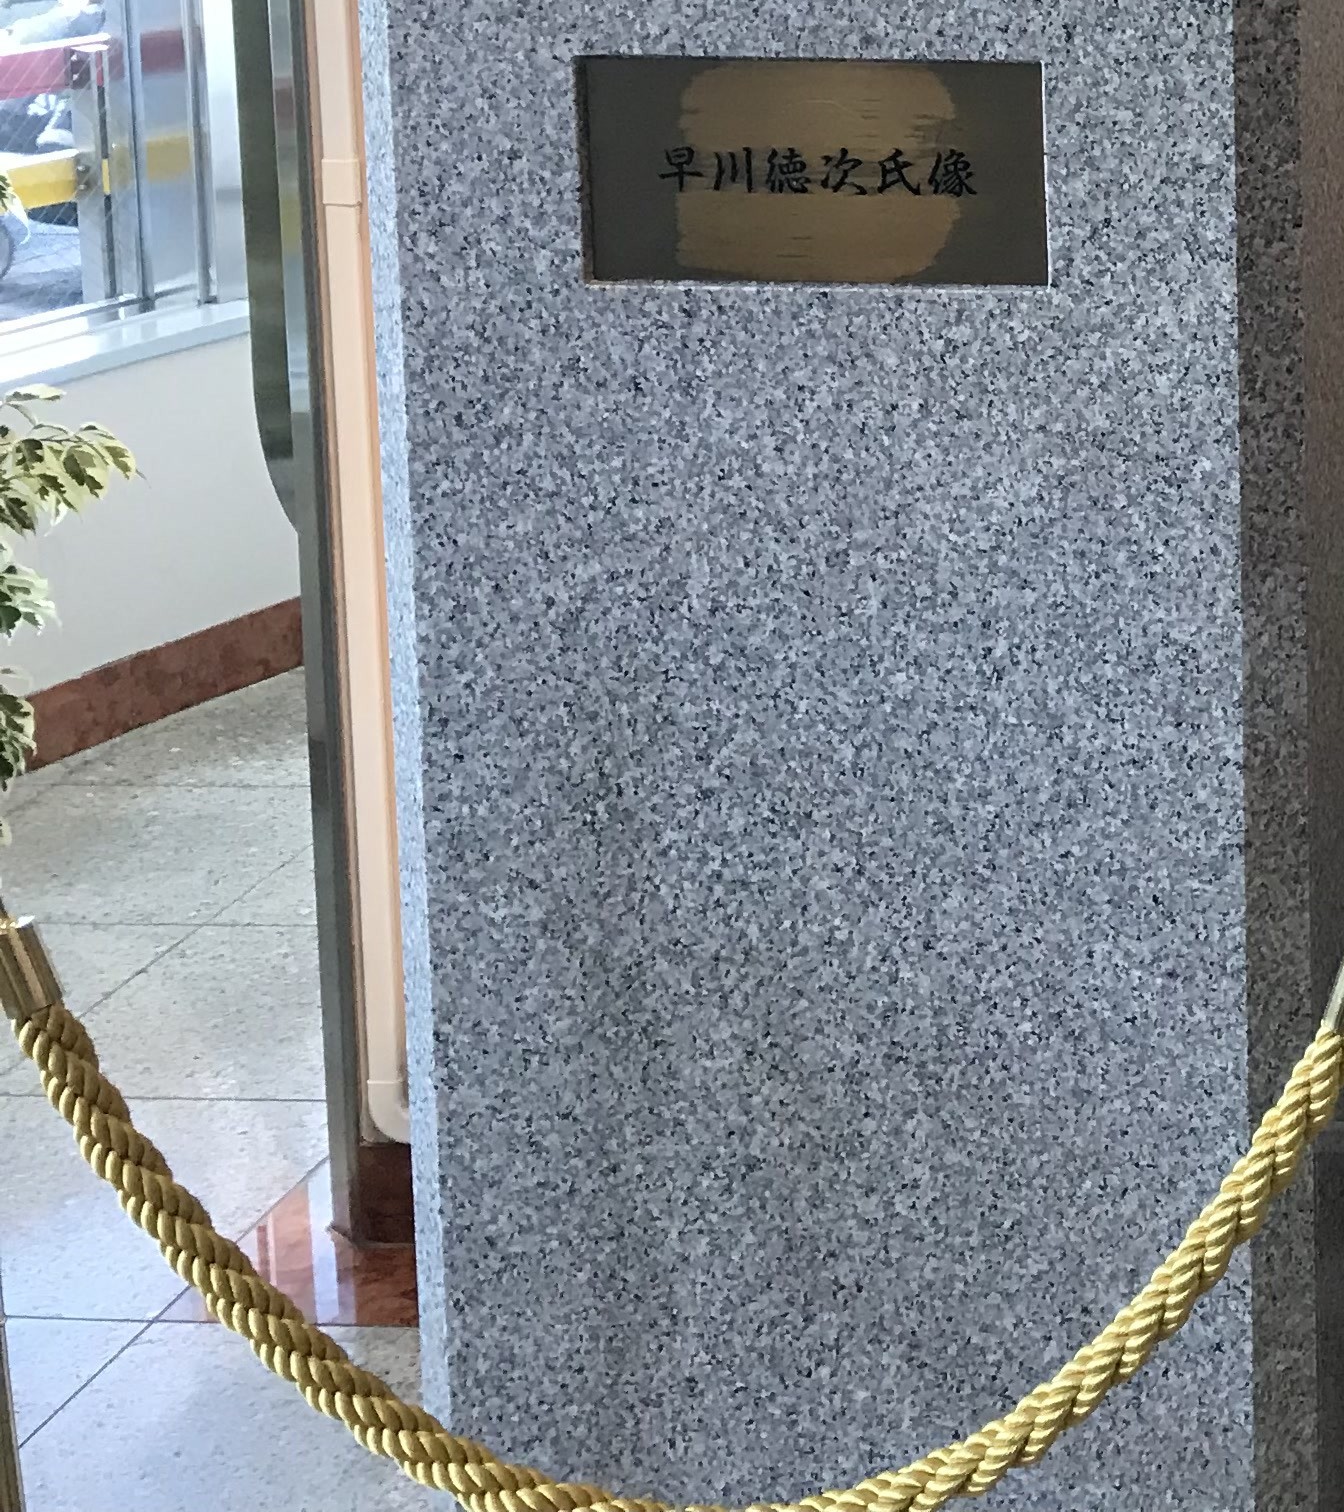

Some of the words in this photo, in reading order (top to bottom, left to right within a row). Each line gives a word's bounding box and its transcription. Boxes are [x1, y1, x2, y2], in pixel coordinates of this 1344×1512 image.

[659, 146, 978, 196] 早川徳次氏像
